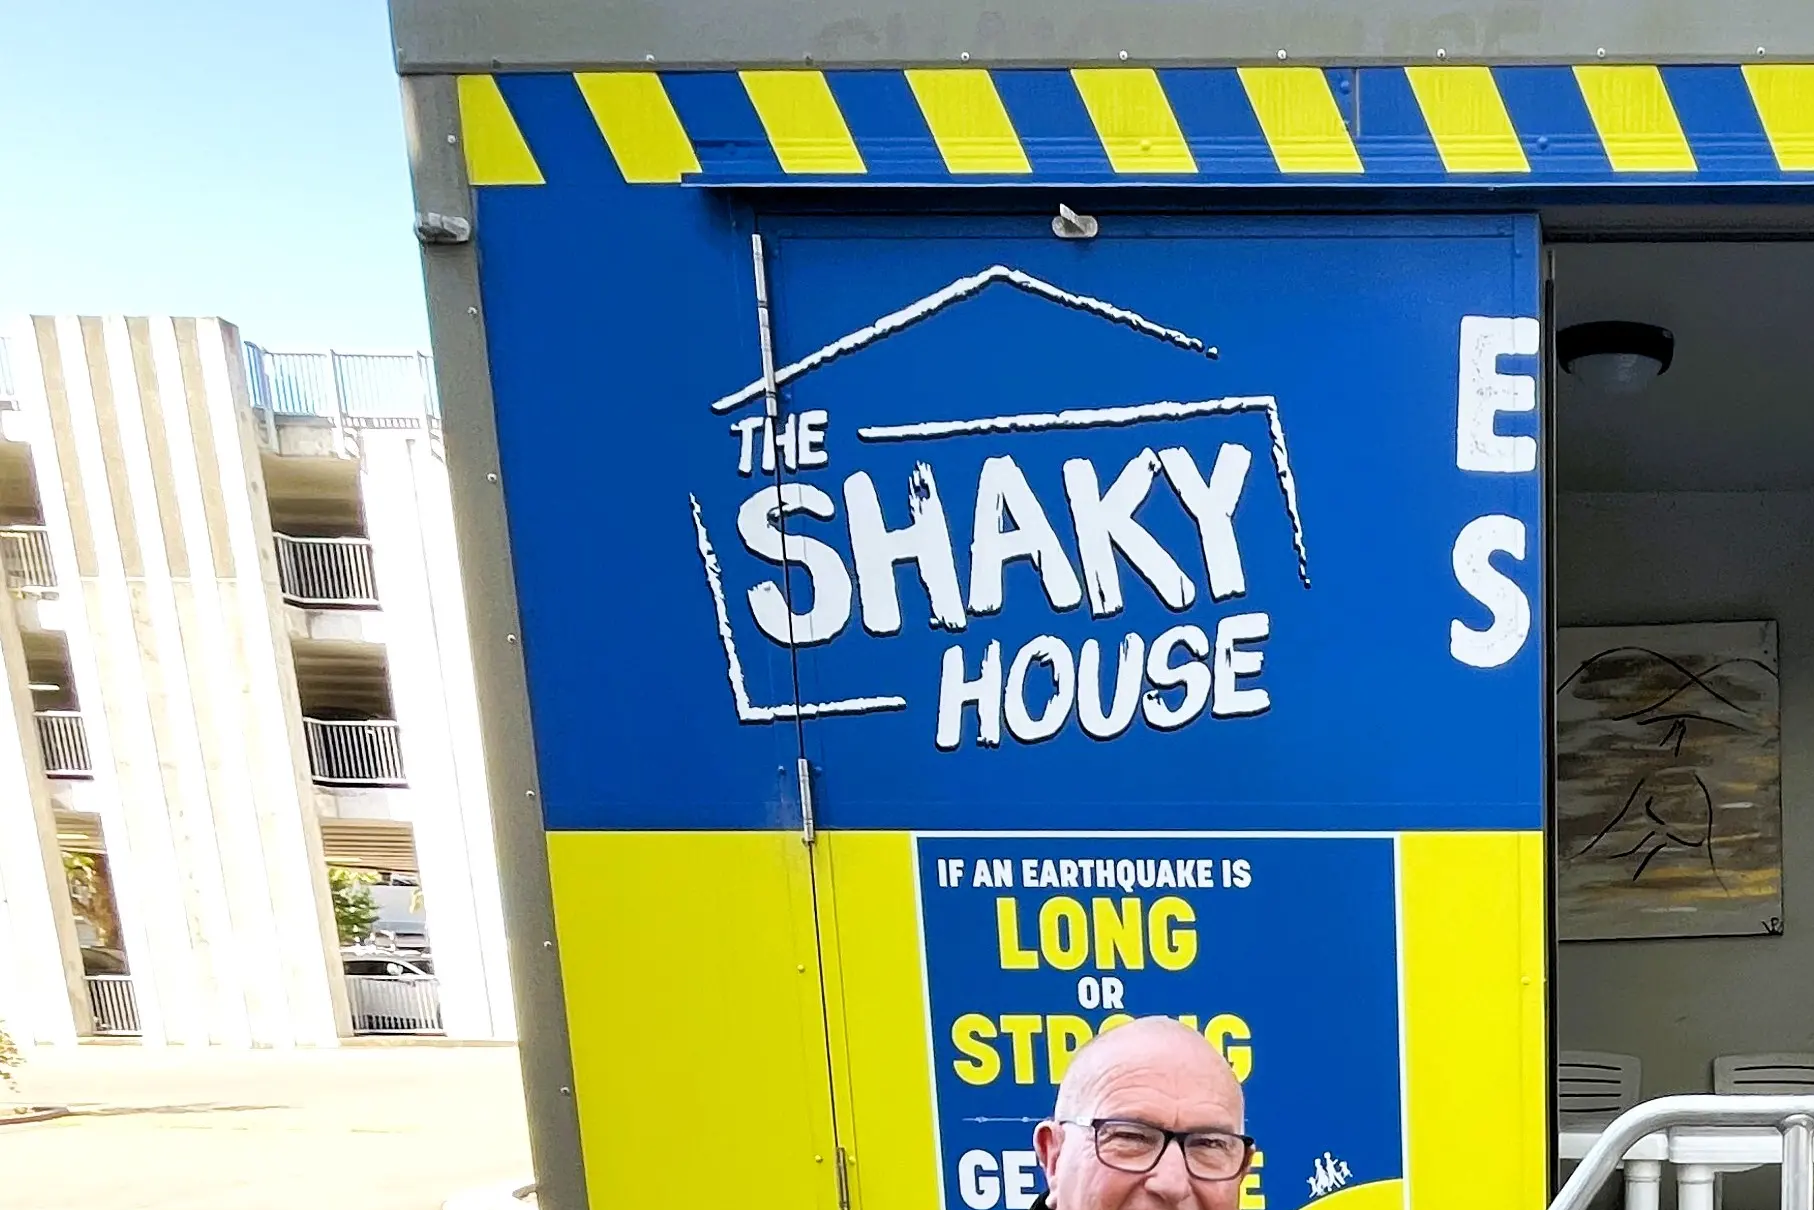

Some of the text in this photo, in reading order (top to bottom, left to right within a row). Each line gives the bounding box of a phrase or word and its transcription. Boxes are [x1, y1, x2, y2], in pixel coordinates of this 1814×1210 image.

[1456, 315, 1540, 473] E
[730, 409, 828, 474] THE
[735, 440, 1251, 647] SHAKY
[1448, 513, 1529, 667] S
[936, 612, 1272, 748] HOUSE
[937, 858, 1252, 892] IF AN EARTHQUAKE IS
[997, 895, 1198, 972] LONG
[1078, 977, 1125, 1010] OR
[952, 1014, 1252, 1085] STRG
[958, 1150, 1041, 1210] GE
